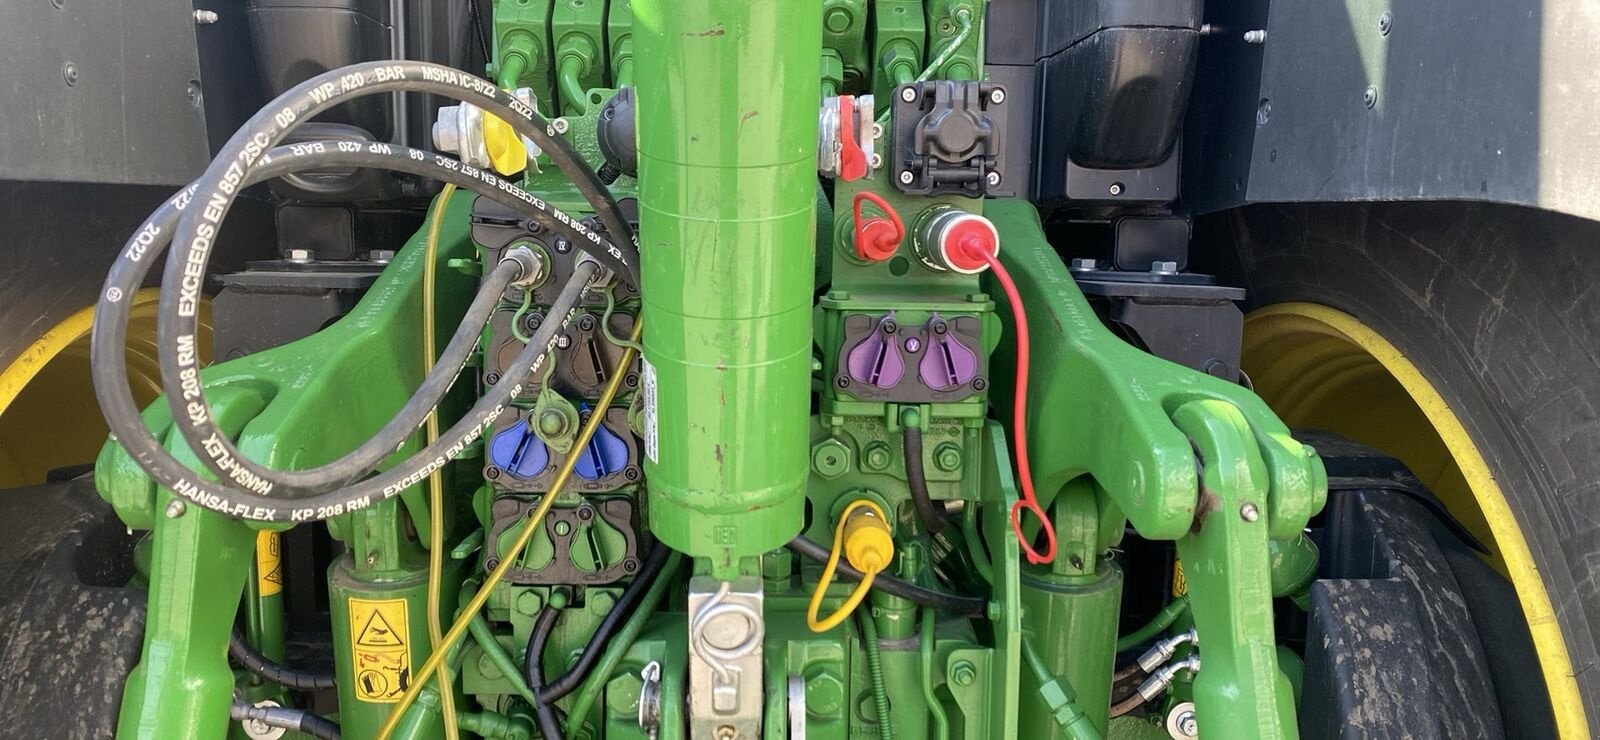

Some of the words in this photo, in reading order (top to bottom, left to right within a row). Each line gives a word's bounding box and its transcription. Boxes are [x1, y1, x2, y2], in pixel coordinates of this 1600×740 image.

[340, 72, 364, 92] 420
[374, 66, 406, 82] BAR
[421, 66, 458, 85] MSHA
[308, 82, 336, 105] WP
[275, 108, 296, 129] 08
[508, 98, 532, 120] 2Q22
[239, 132, 270, 166] 2SC
[290, 142, 324, 156] BAR
[337, 142, 362, 153] 420
[368, 143, 392, 155] WP
[410, 149, 424, 161] 08
[436, 154, 459, 171] 2SC
[460, 166, 479, 179] 857
[218, 164, 244, 195] 857
[480, 172, 497, 186] EN
[498, 178, 546, 210] EXCEEDS
[203, 195, 232, 224] EN
[553, 208, 570, 224] RM
[570, 220, 586, 235] 208
[125, 222, 161, 262] 2Q22
[588, 232, 601, 245] KP
[178, 223, 215, 317] EXCEEDS
[176, 334, 195, 367] RM
[559, 337, 567, 347] III
[910, 341, 917, 351] V
[180, 368, 200, 400] 208
[188, 402, 208, 426] KP
[173, 478, 276, 521] HANSA-FLEX
[291, 508, 314, 521] KP
[316, 504, 343, 520] 208
[346, 496, 370, 512] RM
[382, 455, 446, 498] EXCEEDS
[445, 443, 464, 460] EN
[464, 424, 482, 445] 857
[483, 404, 504, 428] 2SC
[510, 384, 522, 399] 08
[530, 354, 545, 373] WP
[201, 433, 274, 495] HANSA-FLEX
